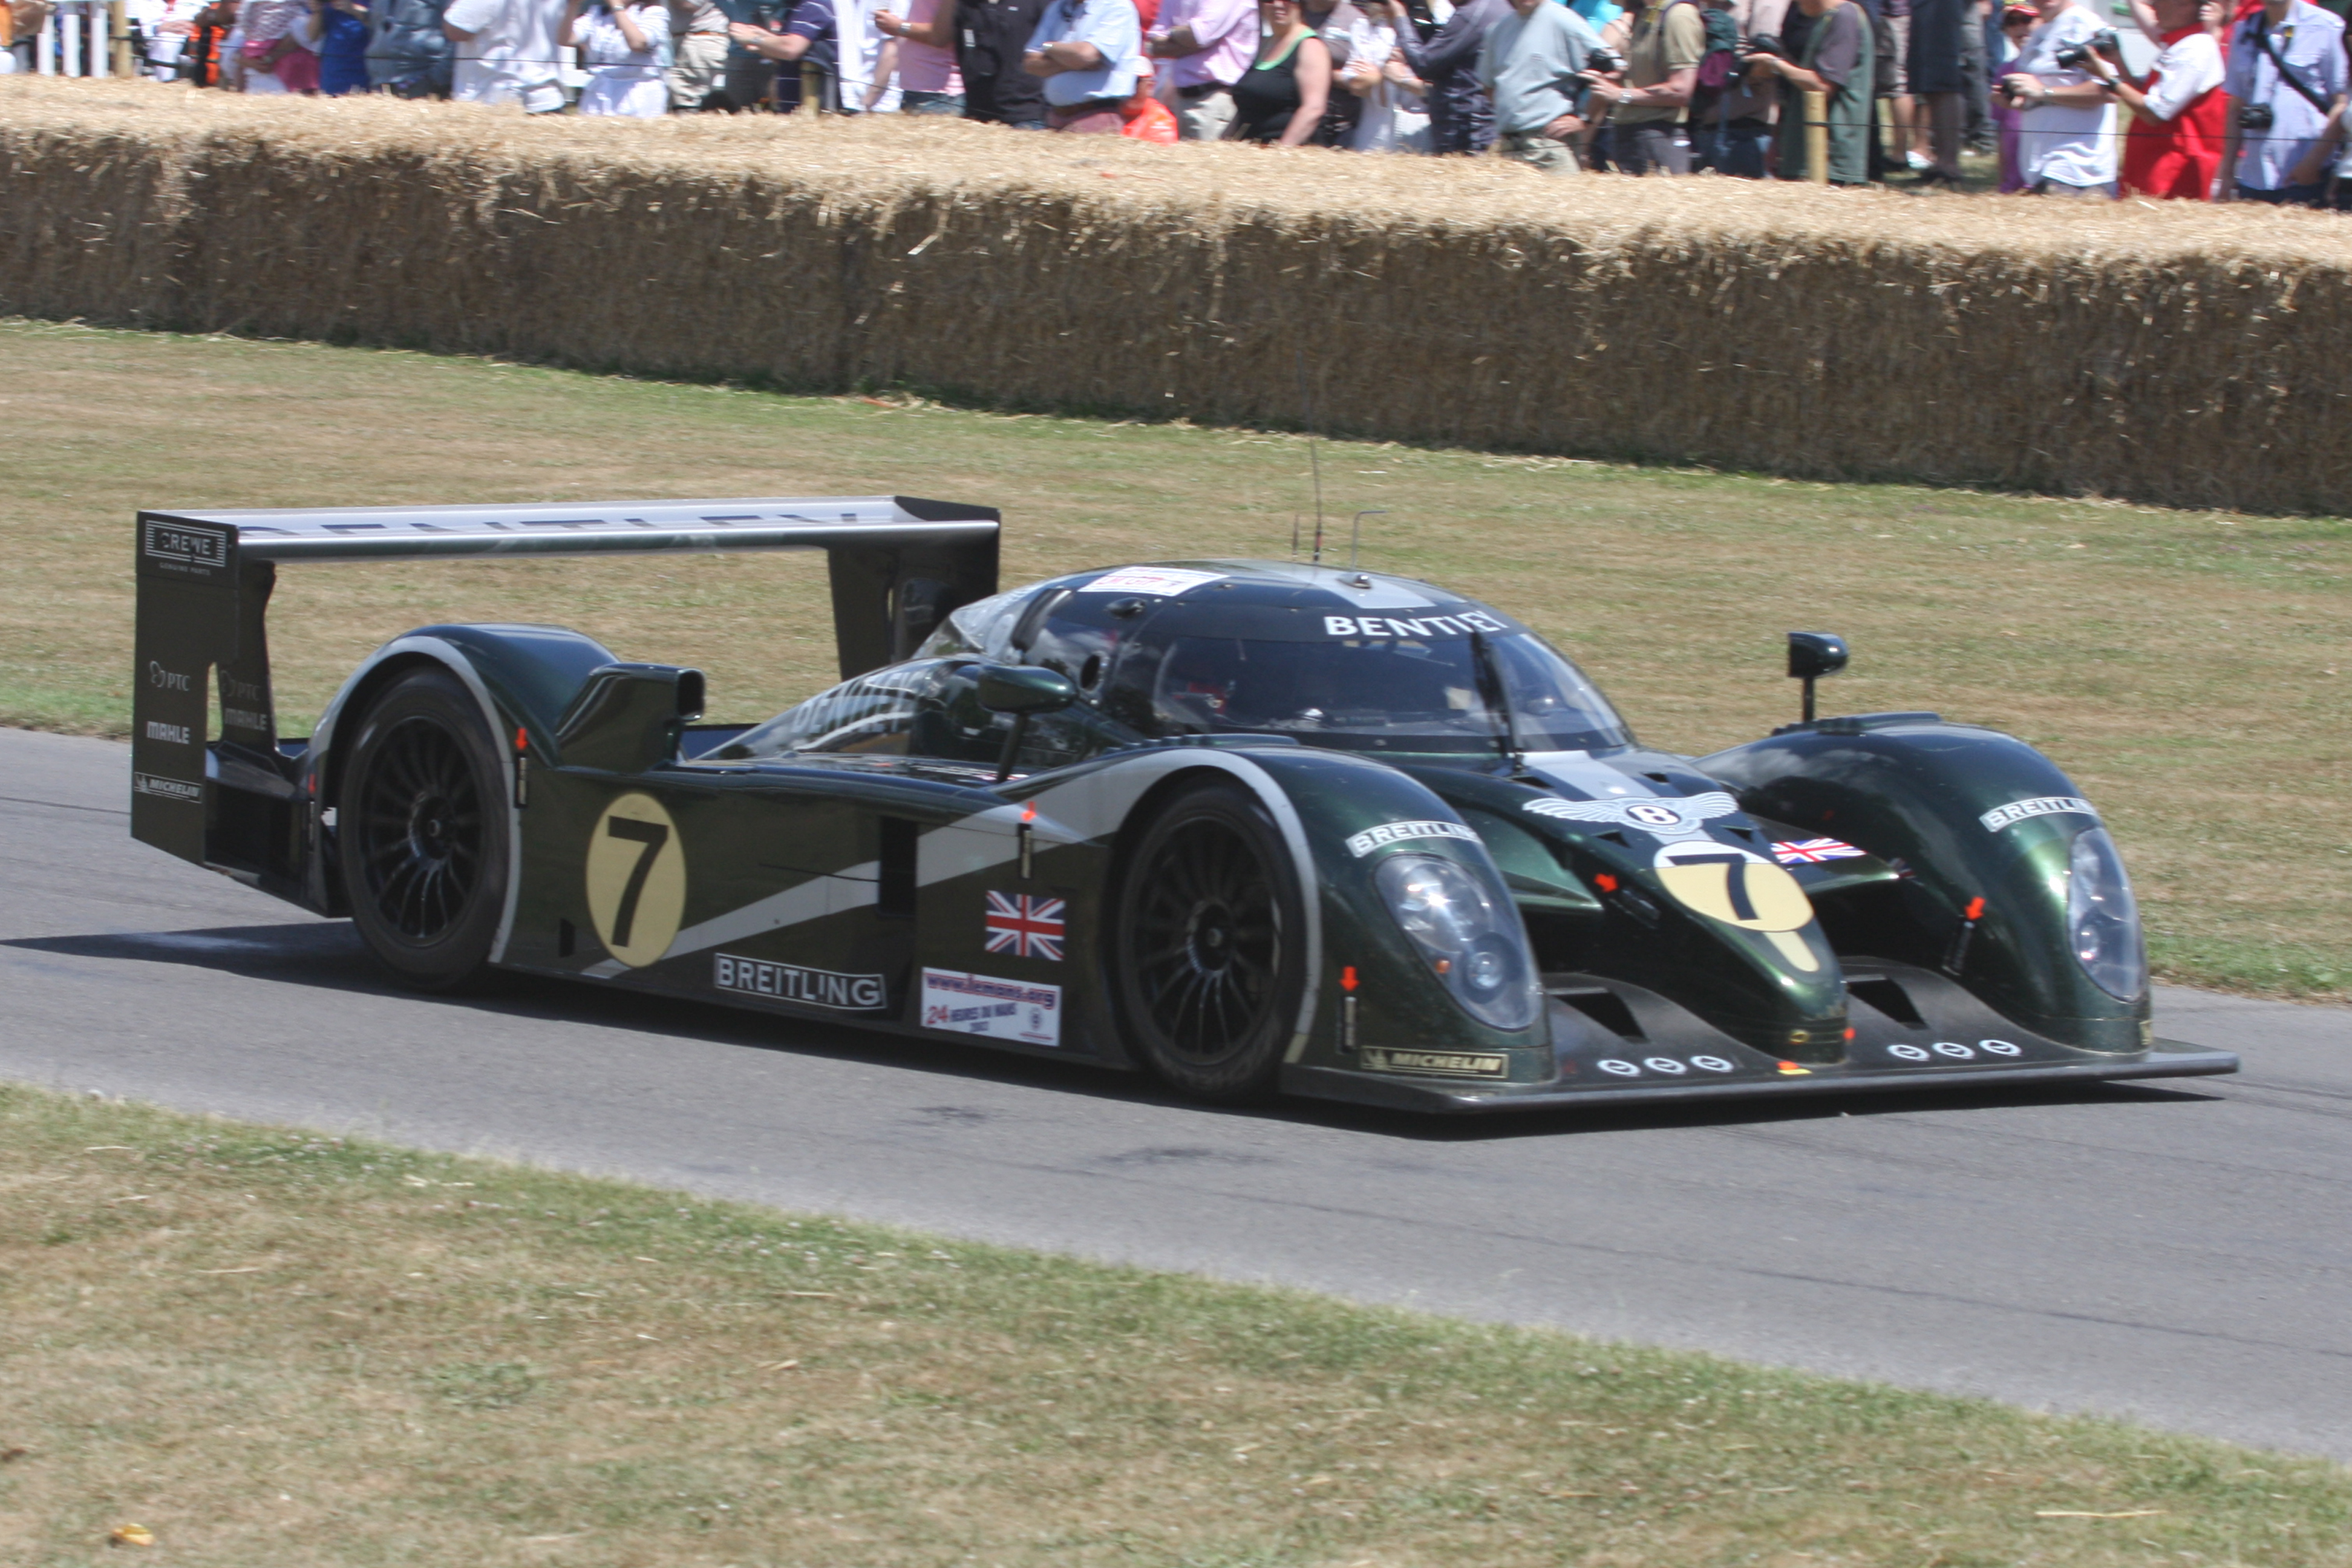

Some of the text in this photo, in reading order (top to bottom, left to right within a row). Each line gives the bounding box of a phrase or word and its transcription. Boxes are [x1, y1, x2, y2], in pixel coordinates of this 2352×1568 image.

[160, 532, 211, 555] CREWE
[167, 673, 190, 691] PTC
[147, 721, 191, 745] MAHLE
[149, 779, 201, 797] MICHELIN
[608, 815, 669, 948] 7
[1664, 852, 1761, 921] 7
[717, 958, 881, 1006] BREITLING
[924, 972, 1057, 1010] www.lemans.org
[926, 1005, 949, 1024] 24
[1393, 1052, 1502, 1071] MICHELIN
